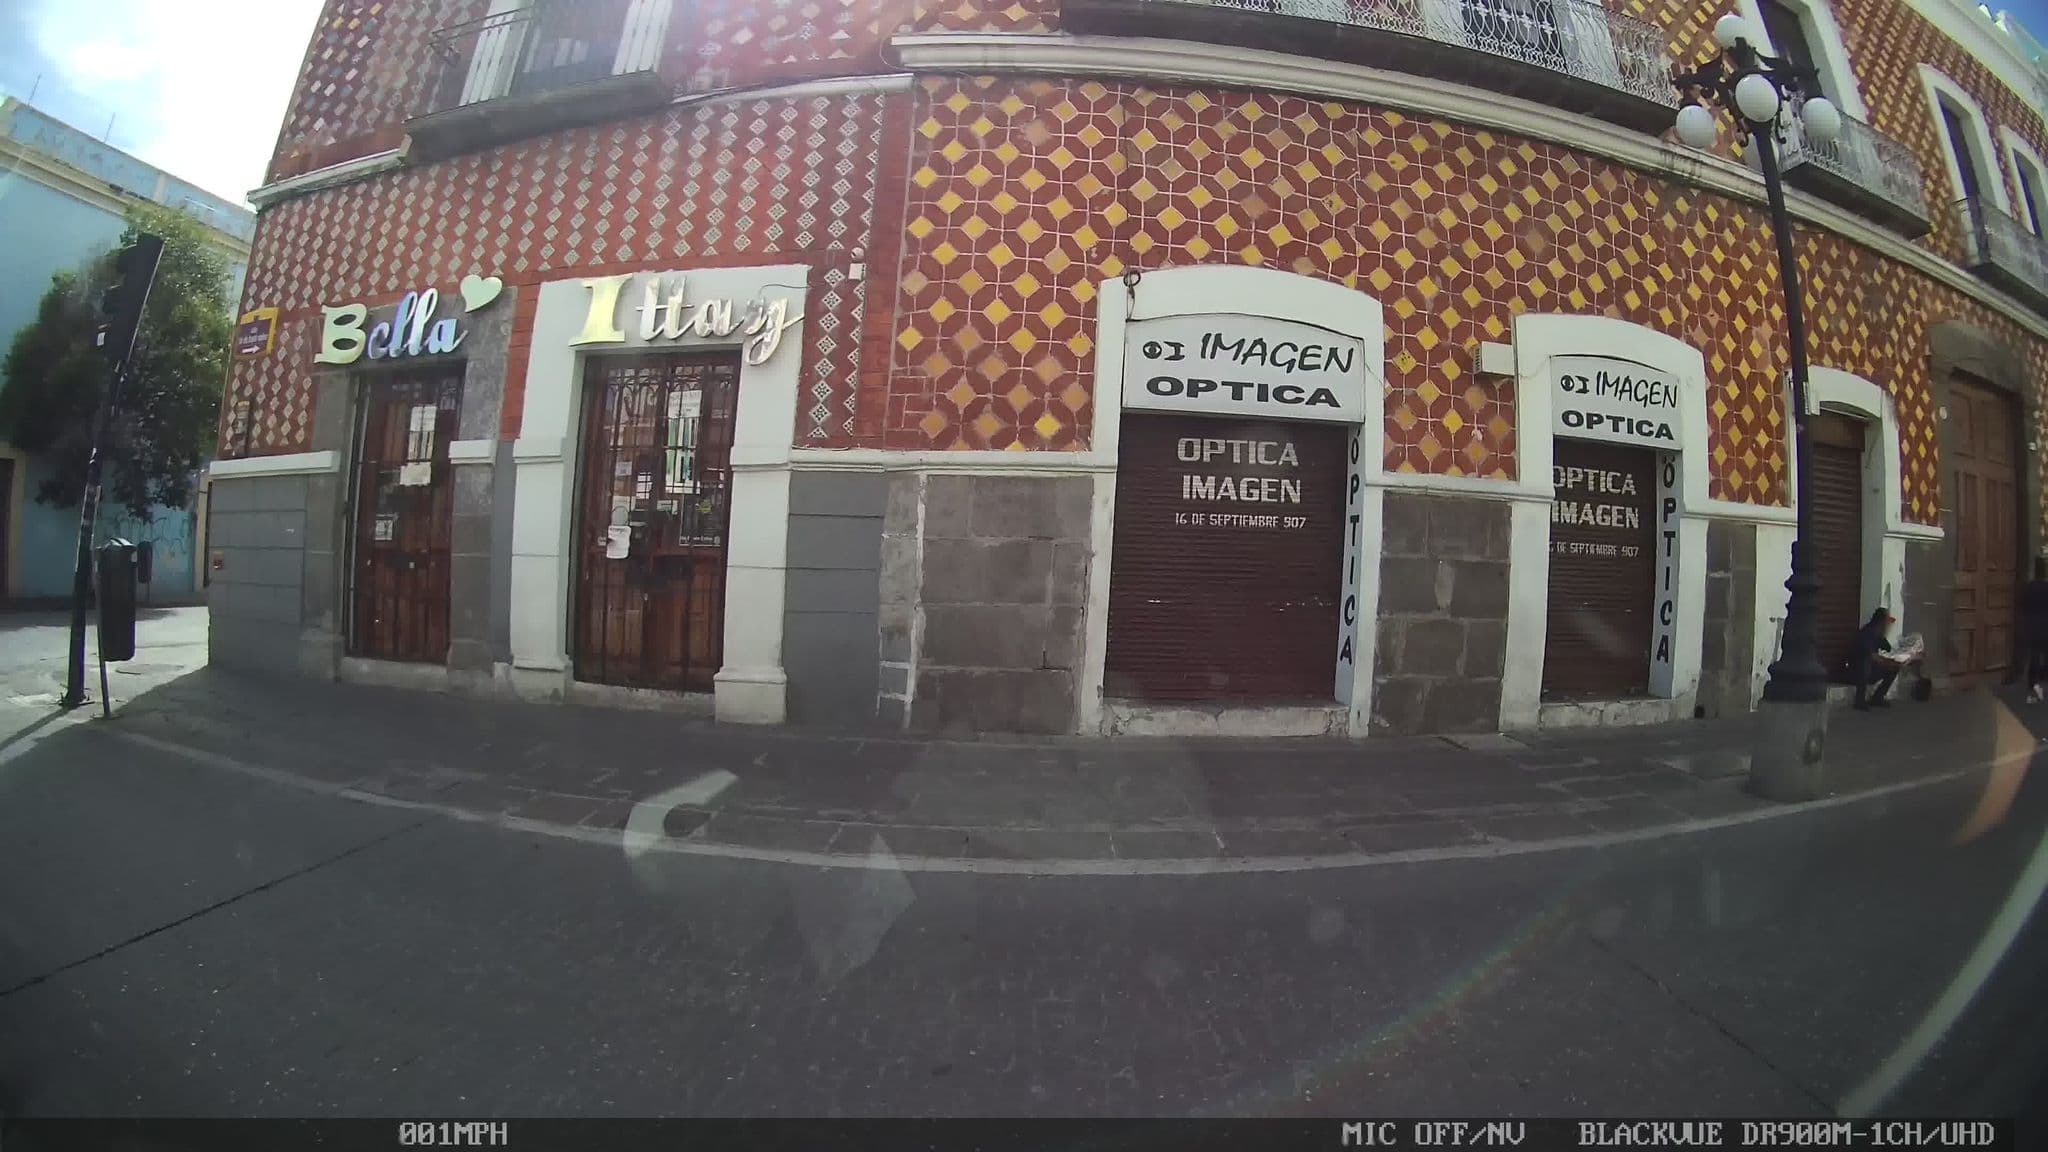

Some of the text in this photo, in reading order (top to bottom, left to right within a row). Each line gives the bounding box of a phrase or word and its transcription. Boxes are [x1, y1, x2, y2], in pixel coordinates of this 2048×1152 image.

[314, 287, 468, 364] Bella
[1200, 333, 1354, 373] IMAGEN
[1146, 376, 1341, 408] OPTICA
[1596, 371, 1678, 409] IMAGEN
[1561, 409, 1675, 441] OPTICA
[1177, 437, 1299, 467] OPTICA
[1182, 474, 1301, 504] IMAGEN
[1175, 512, 1187, 525] 16
[1551, 500, 1639, 529] IMAGEN
